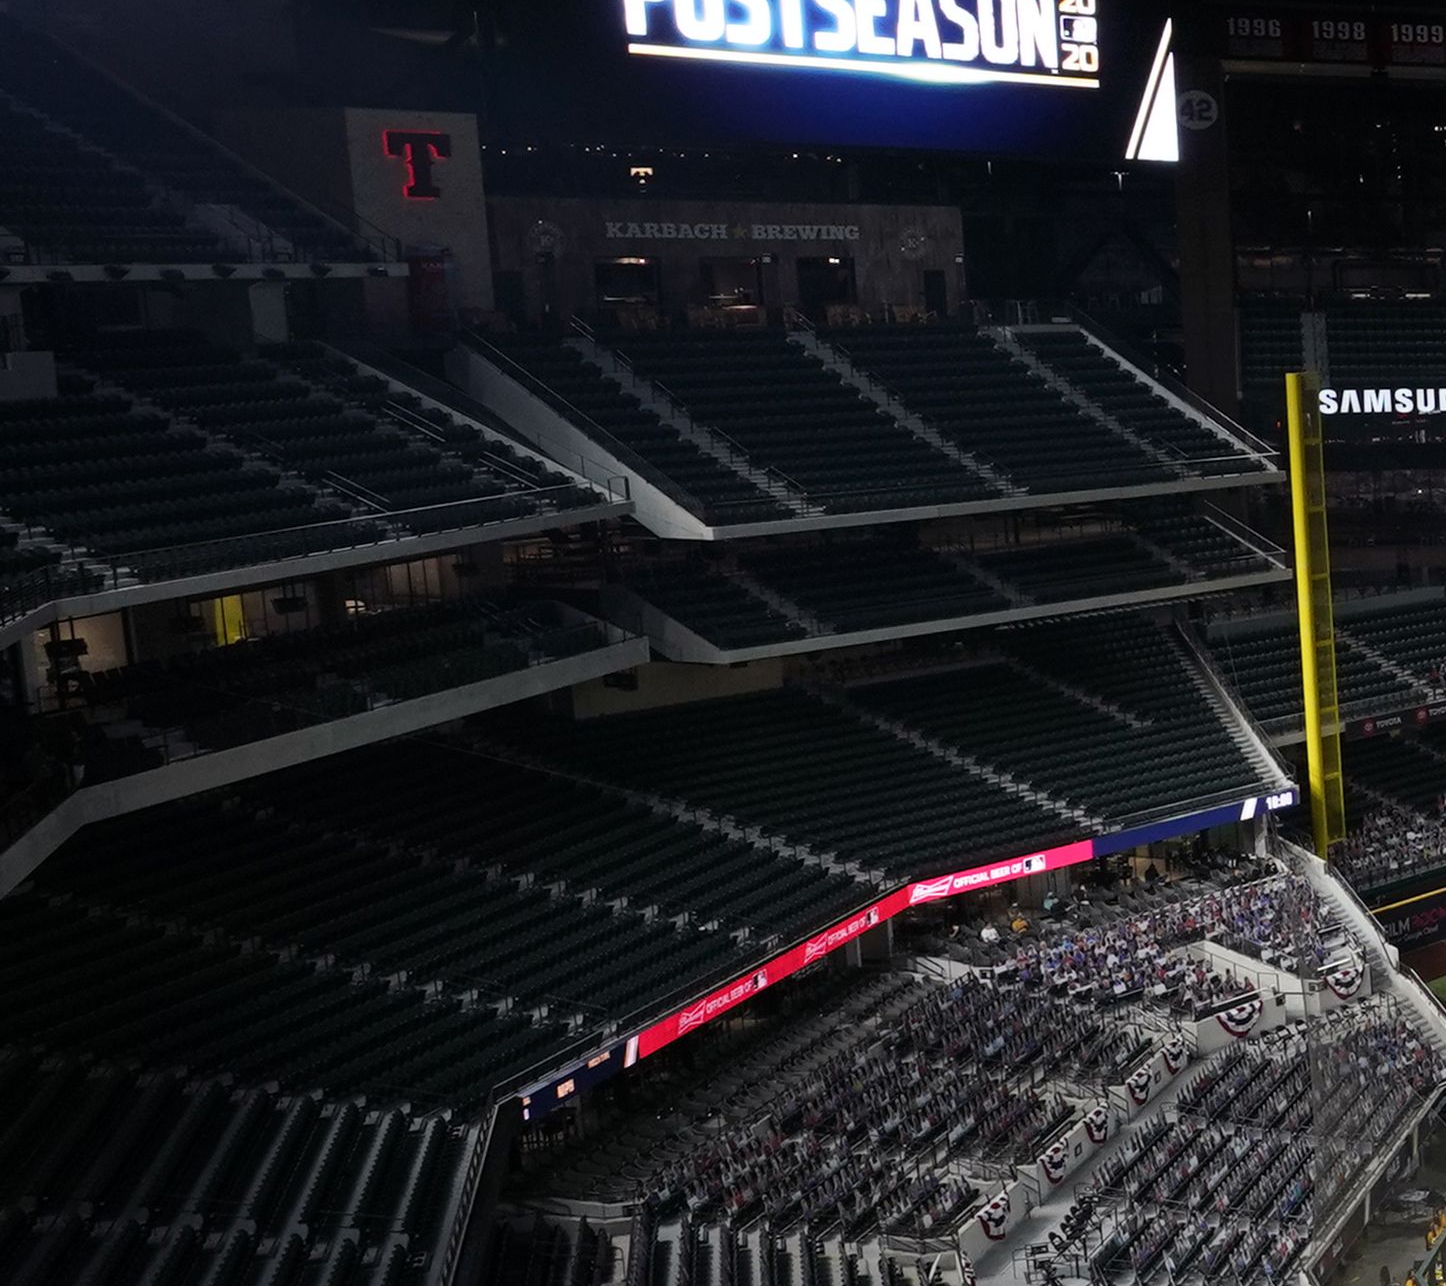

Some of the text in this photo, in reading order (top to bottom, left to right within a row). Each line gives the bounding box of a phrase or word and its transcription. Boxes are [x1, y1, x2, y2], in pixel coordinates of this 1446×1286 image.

[1226, 18, 1281, 38] 1996
[1312, 21, 1366, 41] 1998
[1391, 24, 1444, 44] 1999
[1061, 44, 1098, 72] 20
[1181, 98, 1215, 123] 42
[605, 222, 861, 241] KARBACH BREWING
[1376, 717, 1401, 729] TOYOTA
[953, 872, 990, 890] OFFICIAL
